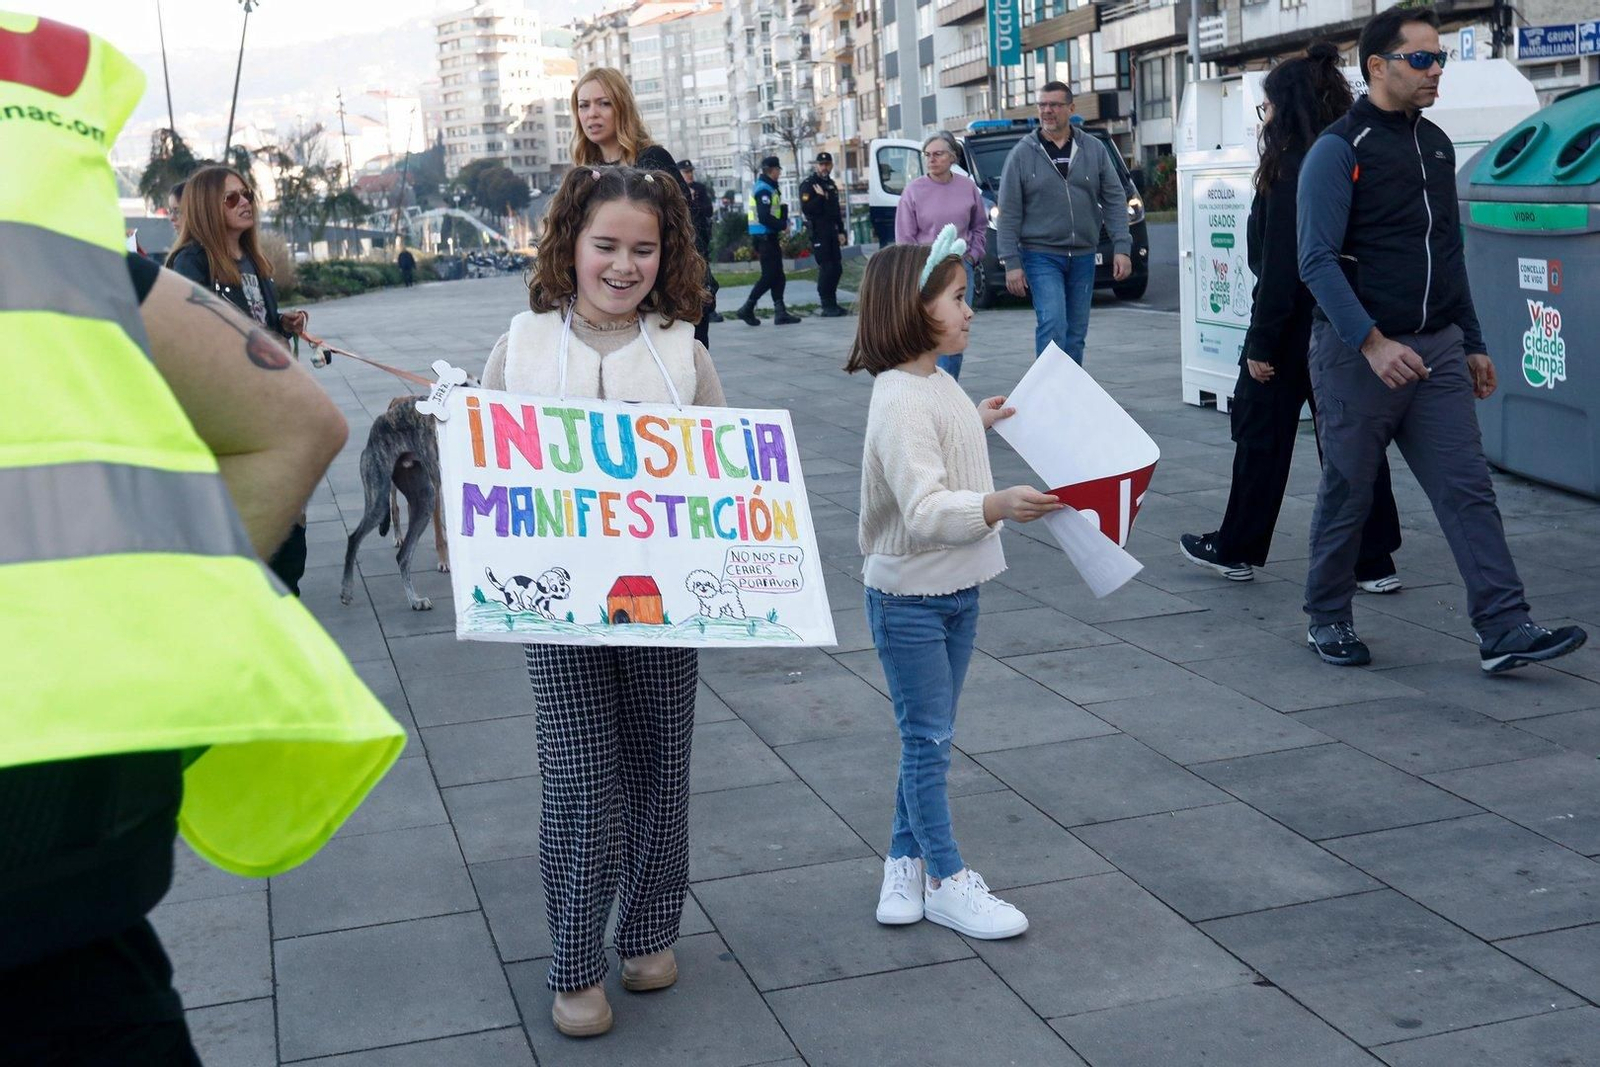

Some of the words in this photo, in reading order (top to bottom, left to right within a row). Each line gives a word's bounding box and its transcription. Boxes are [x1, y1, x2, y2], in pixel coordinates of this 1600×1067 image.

[1547, 30, 1575, 43] GRUPO
[1462, 33, 1472, 58] P
[1520, 43, 1575, 57] INMOBILIARIO
[1207, 189, 1236, 200] RECOLLIDA
[1208, 214, 1236, 228] USADOS
[1513, 211, 1536, 222] VIDRO
[1520, 264, 1546, 275] CONCELLO
[1523, 274, 1531, 282] DE
[1530, 303, 1560, 338] Vigo
[1525, 328, 1564, 358] cidade
[731, 550, 750, 563] NO
[752, 552, 776, 564] NOS
[779, 553, 799, 564] EN
